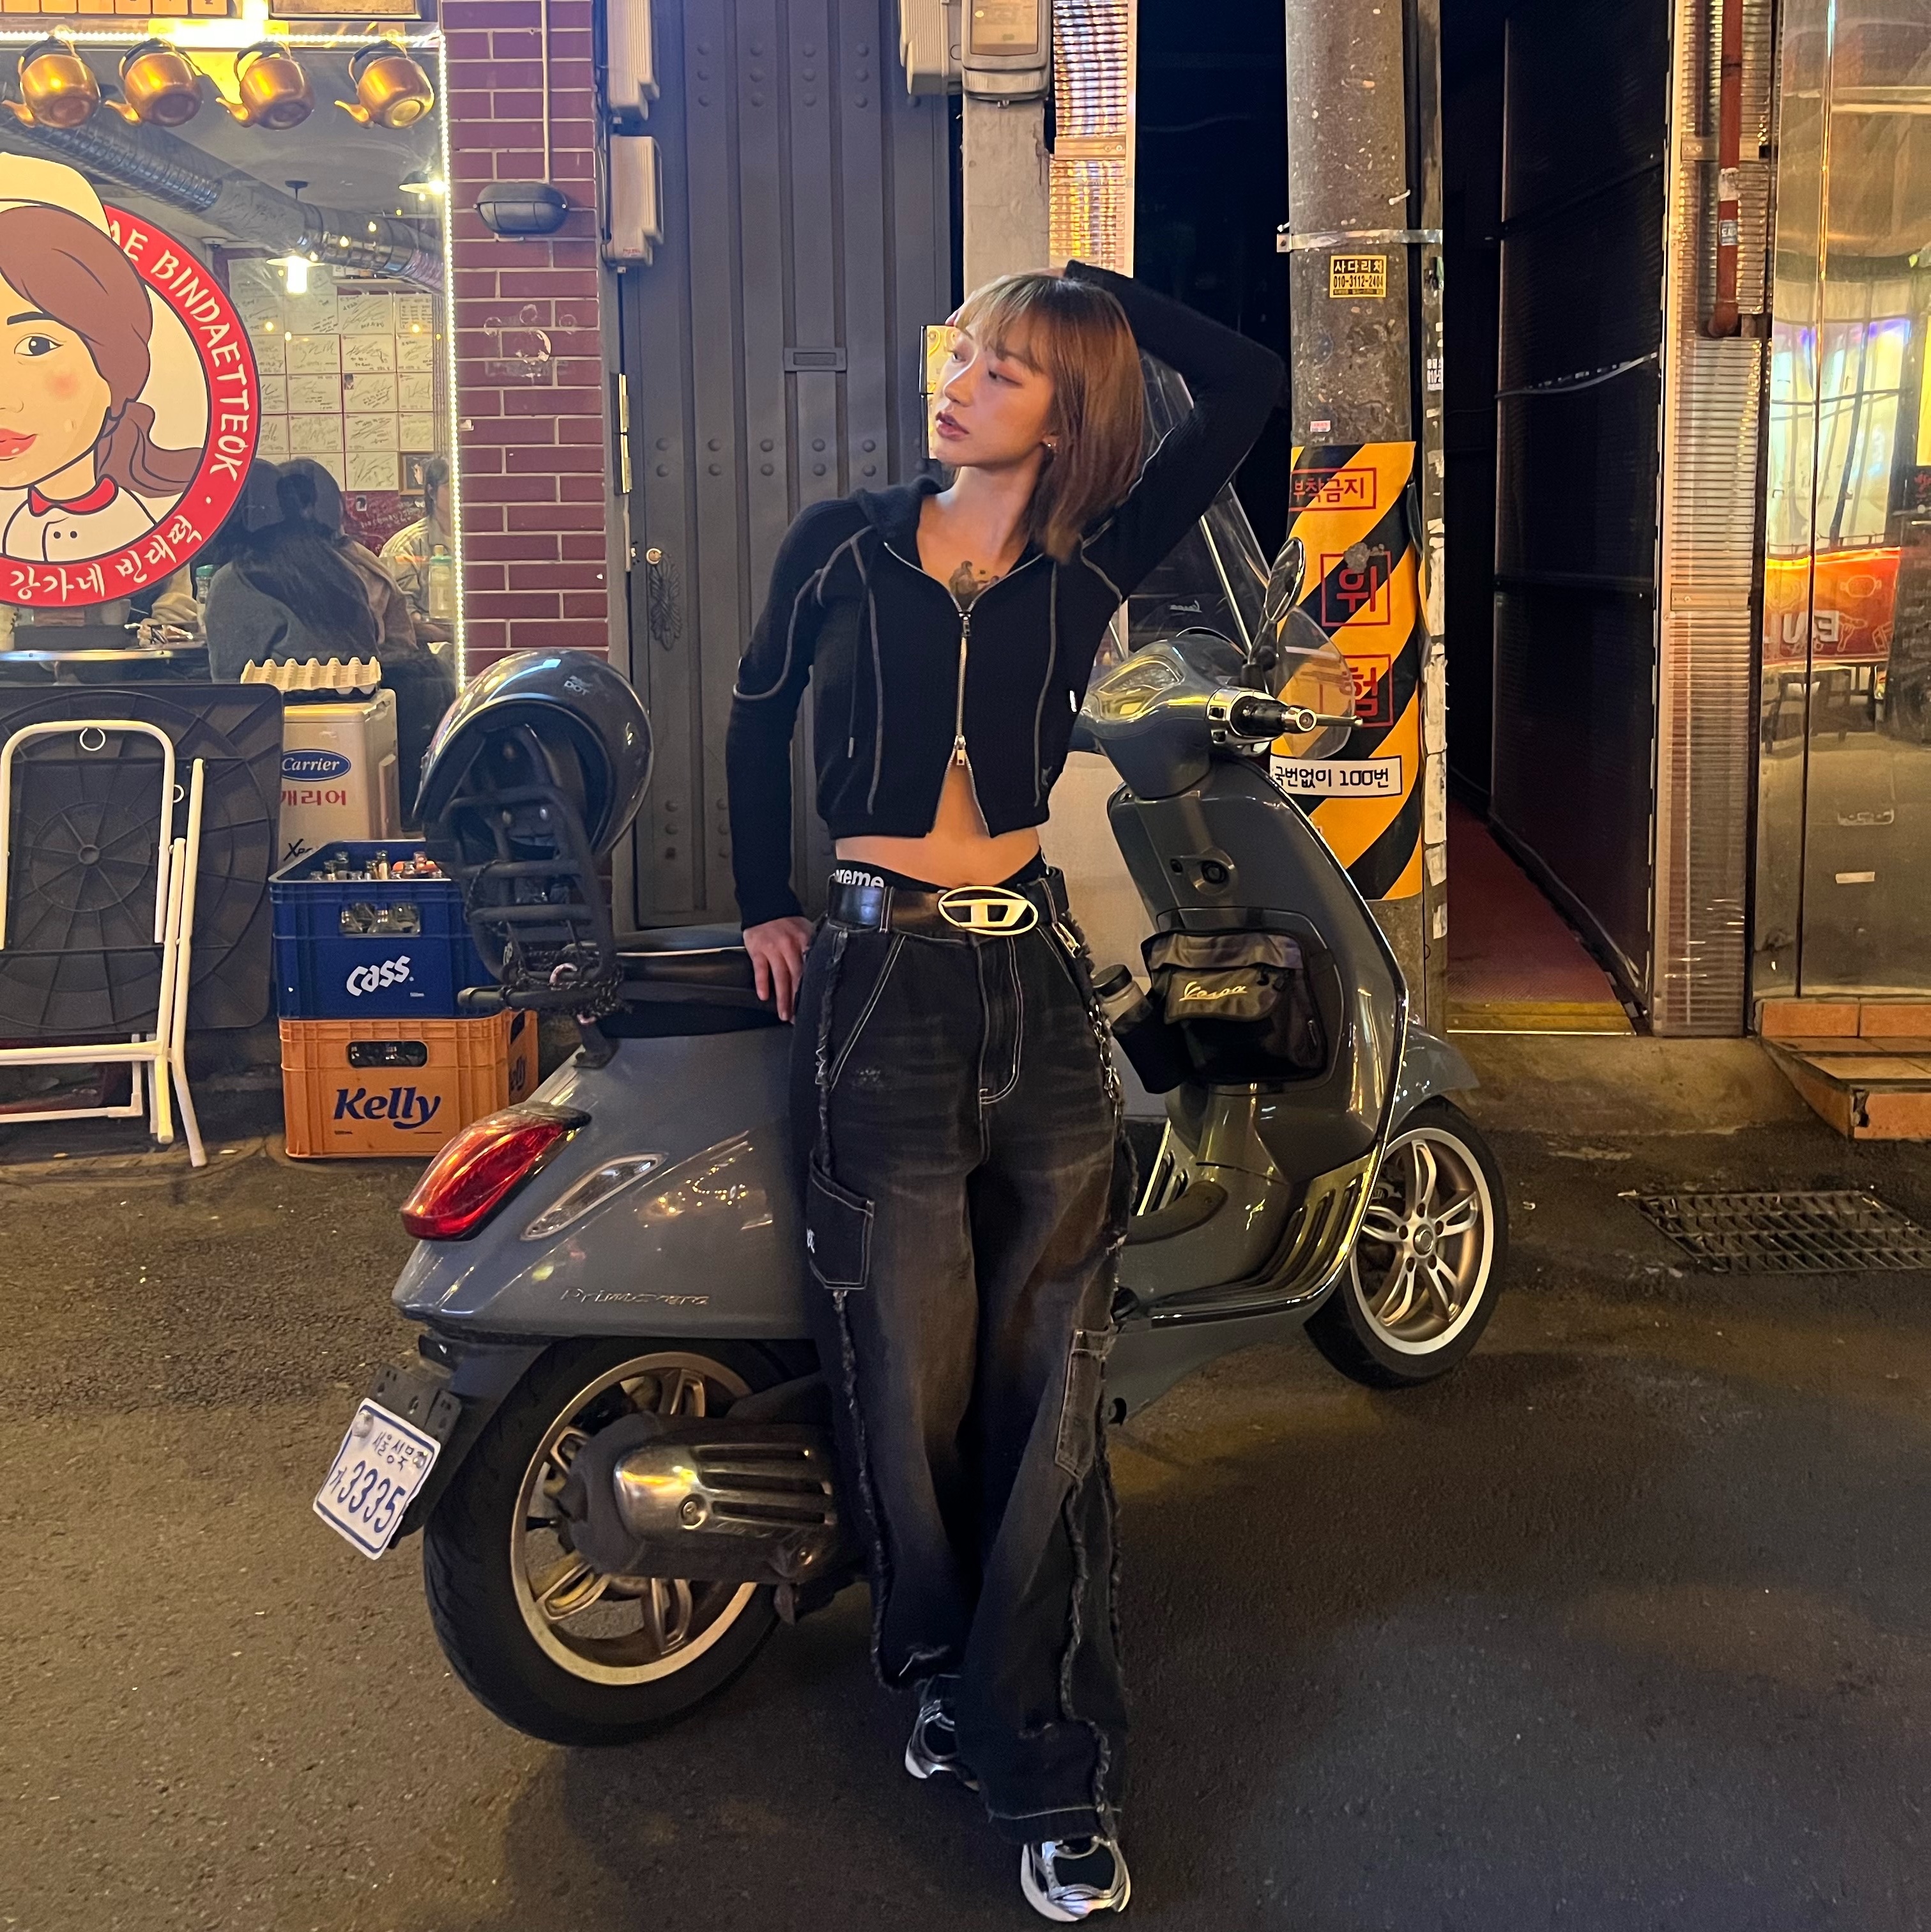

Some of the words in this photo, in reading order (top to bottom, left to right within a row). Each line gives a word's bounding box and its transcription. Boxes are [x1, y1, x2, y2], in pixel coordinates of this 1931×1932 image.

[1334, 259, 1383, 273] 사다리차
[151, 249, 250, 482] BINDAETTEOK
[1293, 477, 1364, 503] 부착금지
[10, 563, 105, 602] 강가네
[114, 515, 203, 583] 빈대떡
[1336, 565, 1377, 613] 위
[563, 680, 591, 696] DOT
[282, 757, 340, 772] Carrier
[1275, 765, 1332, 789] 국번없이
[1339, 767, 1389, 788] 100번
[1179, 981, 1248, 1002] Vespa
[333, 1086, 442, 1130] Kelly
[337, 1459, 406, 1534] 3335
